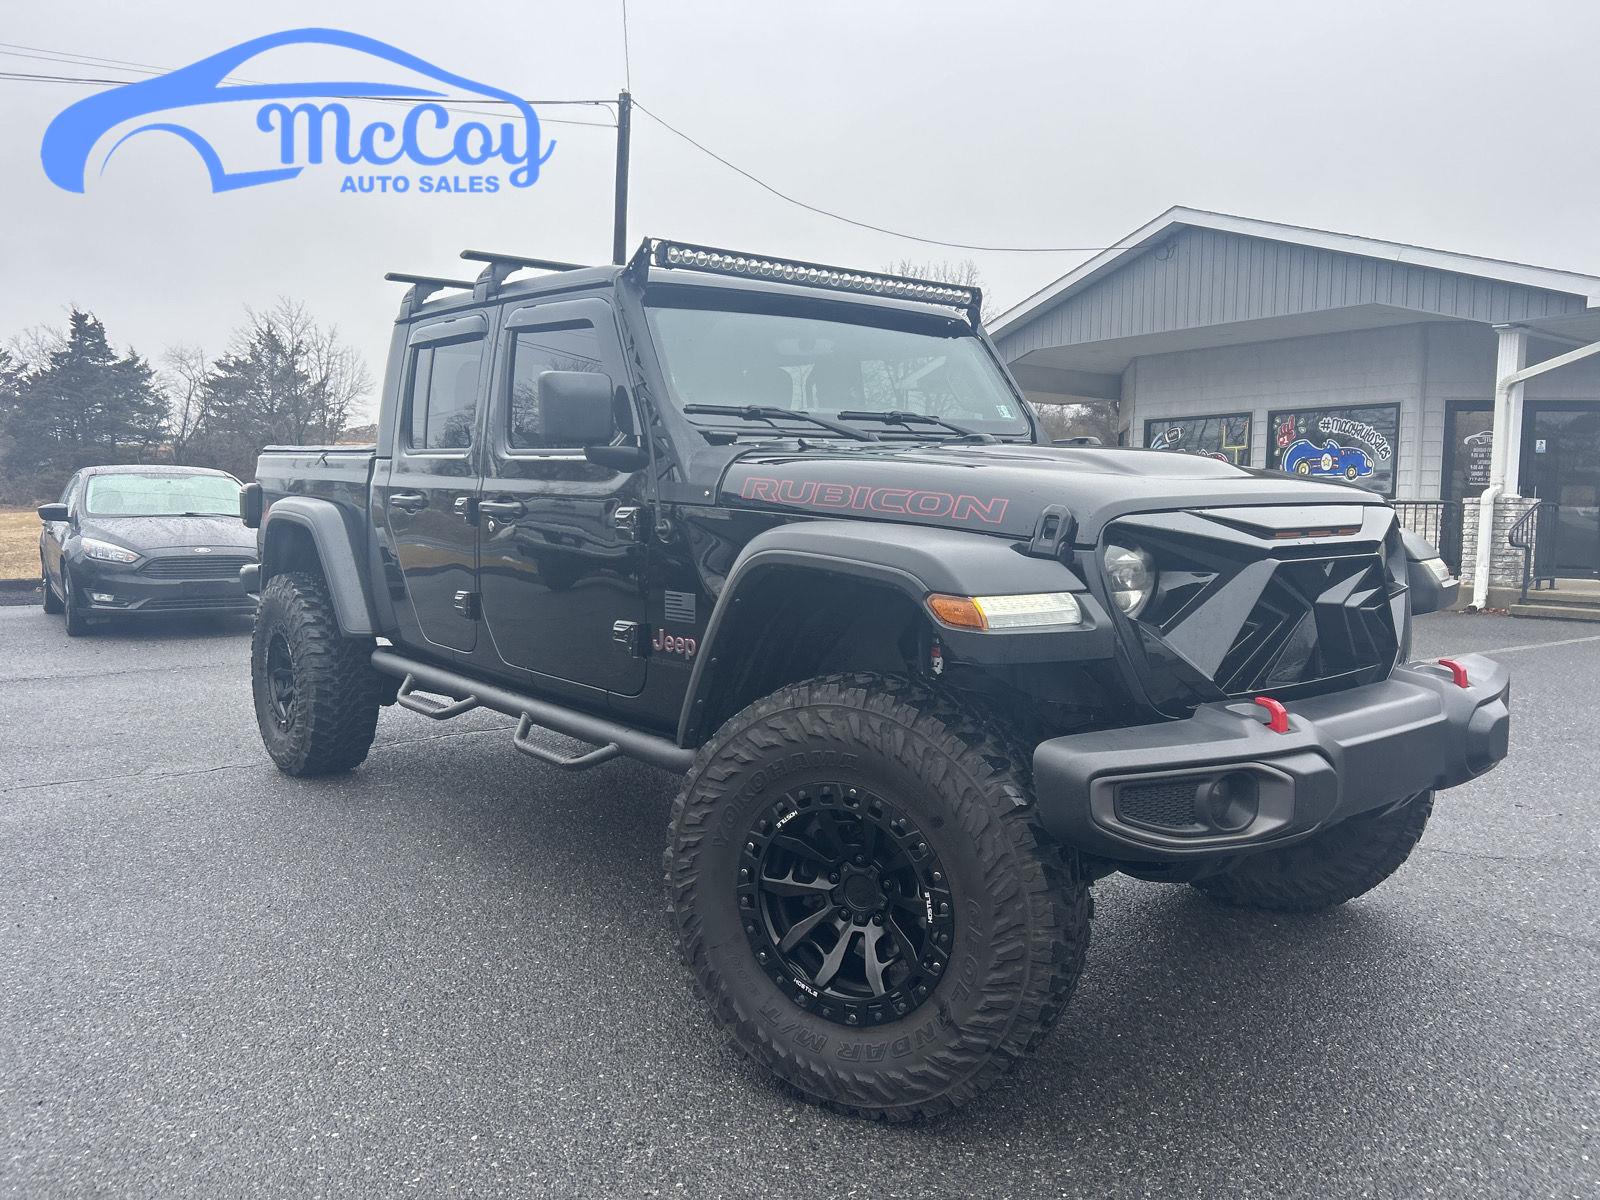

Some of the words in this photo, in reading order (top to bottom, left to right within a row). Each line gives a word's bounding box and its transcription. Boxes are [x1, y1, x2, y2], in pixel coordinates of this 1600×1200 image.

[741, 477, 1009, 524] RUBICON
[652, 628, 697, 660] Jeep
[775, 809, 799, 830] HOSTILE
[924, 891, 934, 924] HOSTILE
[792, 977, 819, 998] HOSTILE
